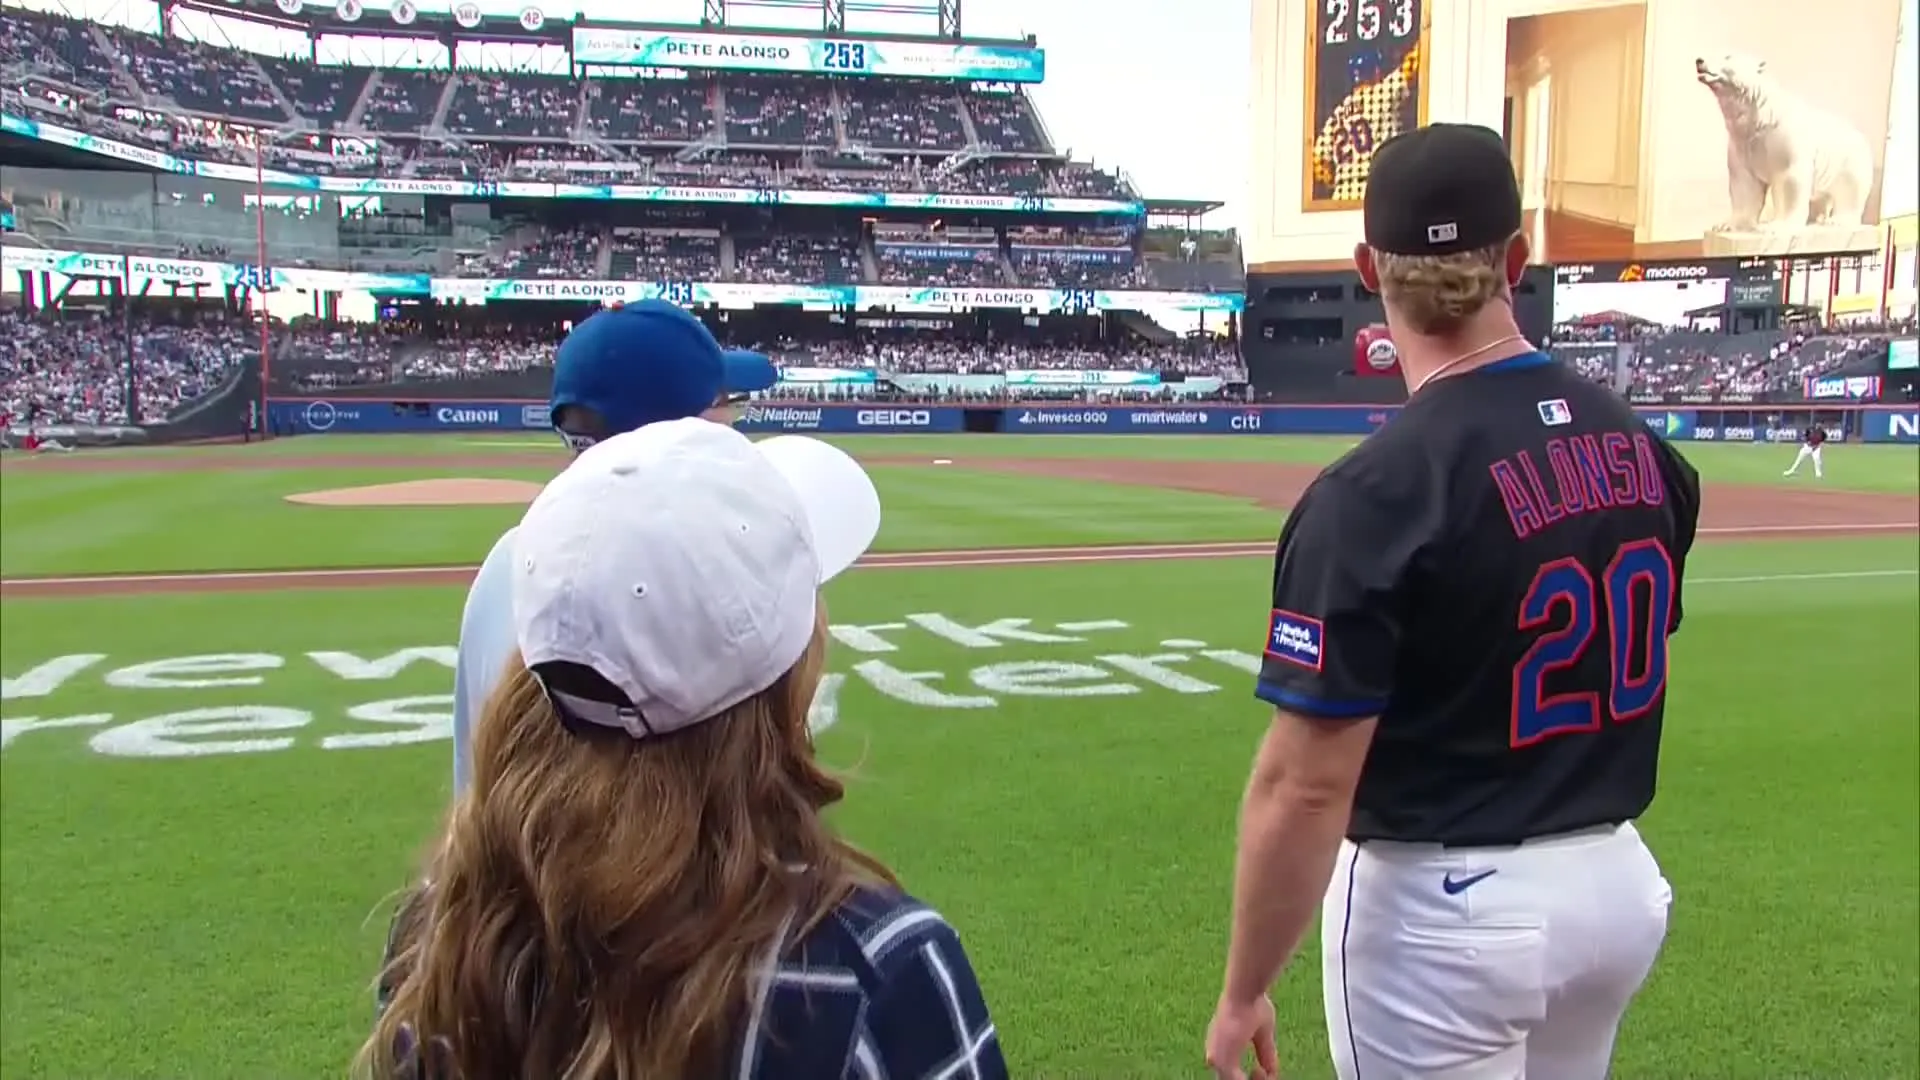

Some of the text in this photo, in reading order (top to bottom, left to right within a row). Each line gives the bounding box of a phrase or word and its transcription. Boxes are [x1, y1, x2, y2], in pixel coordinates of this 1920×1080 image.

[524, 12, 540, 25] 42
[1326, 0, 1412, 44] 253
[666, 42, 865, 69] PETE ALONSO 253
[408, 183, 453, 192] ALONSO
[82, 257, 125, 272] PETE
[134, 259, 204, 277] ALONSO
[1646, 266, 1708, 279] moomoo
[513, 281, 693, 301] PETE ALONSO 253
[932, 289, 1096, 309] PETE ALONSO 253
[437, 408, 499, 423] Canon
[764, 407, 822, 421] National
[857, 410, 930, 425] GEICO
[1038, 411, 1082, 424] Invesco
[1131, 411, 1198, 424] smartwater
[1231, 414, 1261, 430] citi
[1724, 427, 1755, 440] GOYA
[1490, 431, 1664, 540] ALONSO
[1510, 536, 1674, 748] 20
